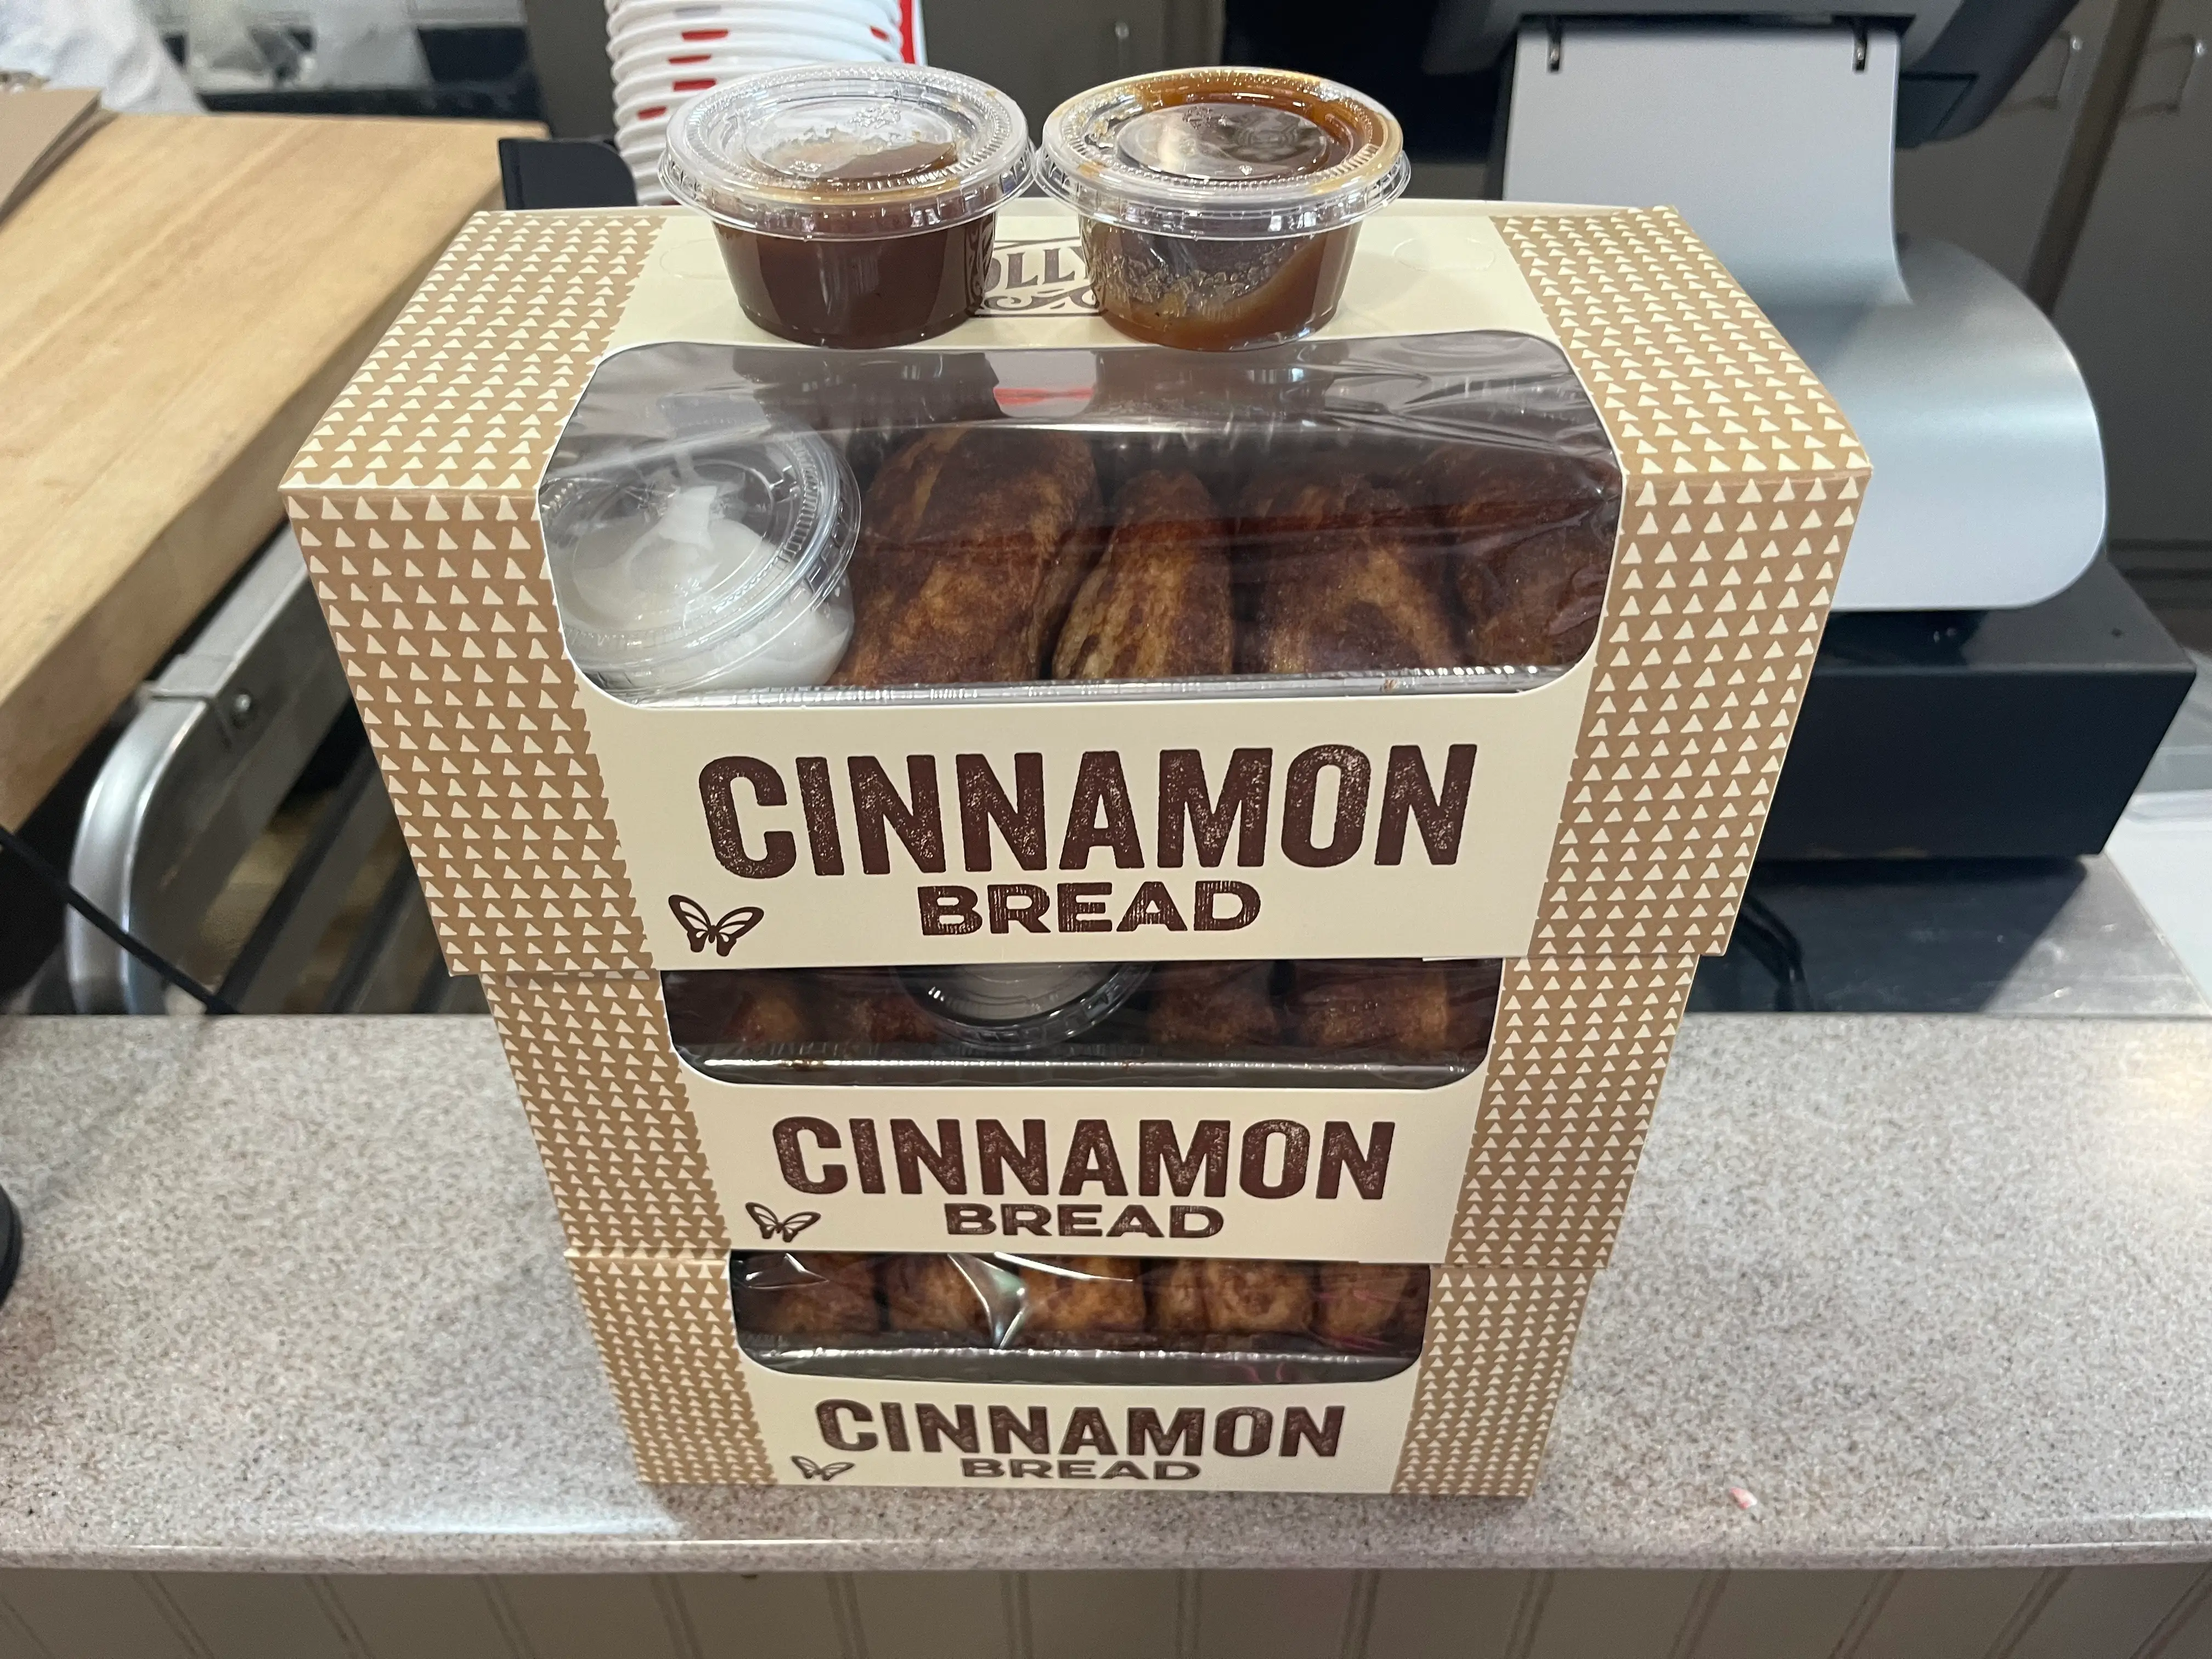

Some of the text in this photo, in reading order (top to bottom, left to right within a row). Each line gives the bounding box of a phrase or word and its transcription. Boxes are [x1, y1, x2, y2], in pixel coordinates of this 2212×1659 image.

[698, 743, 1477, 880] CINNAMON
[917, 880, 1261, 936] BREAD
[772, 1116, 1396, 1200] CINNAMON
[944, 1203, 1224, 1239] BREAD
[815, 1399, 1345, 1458] CINNAMON
[961, 1458, 1201, 1481] BREAD
